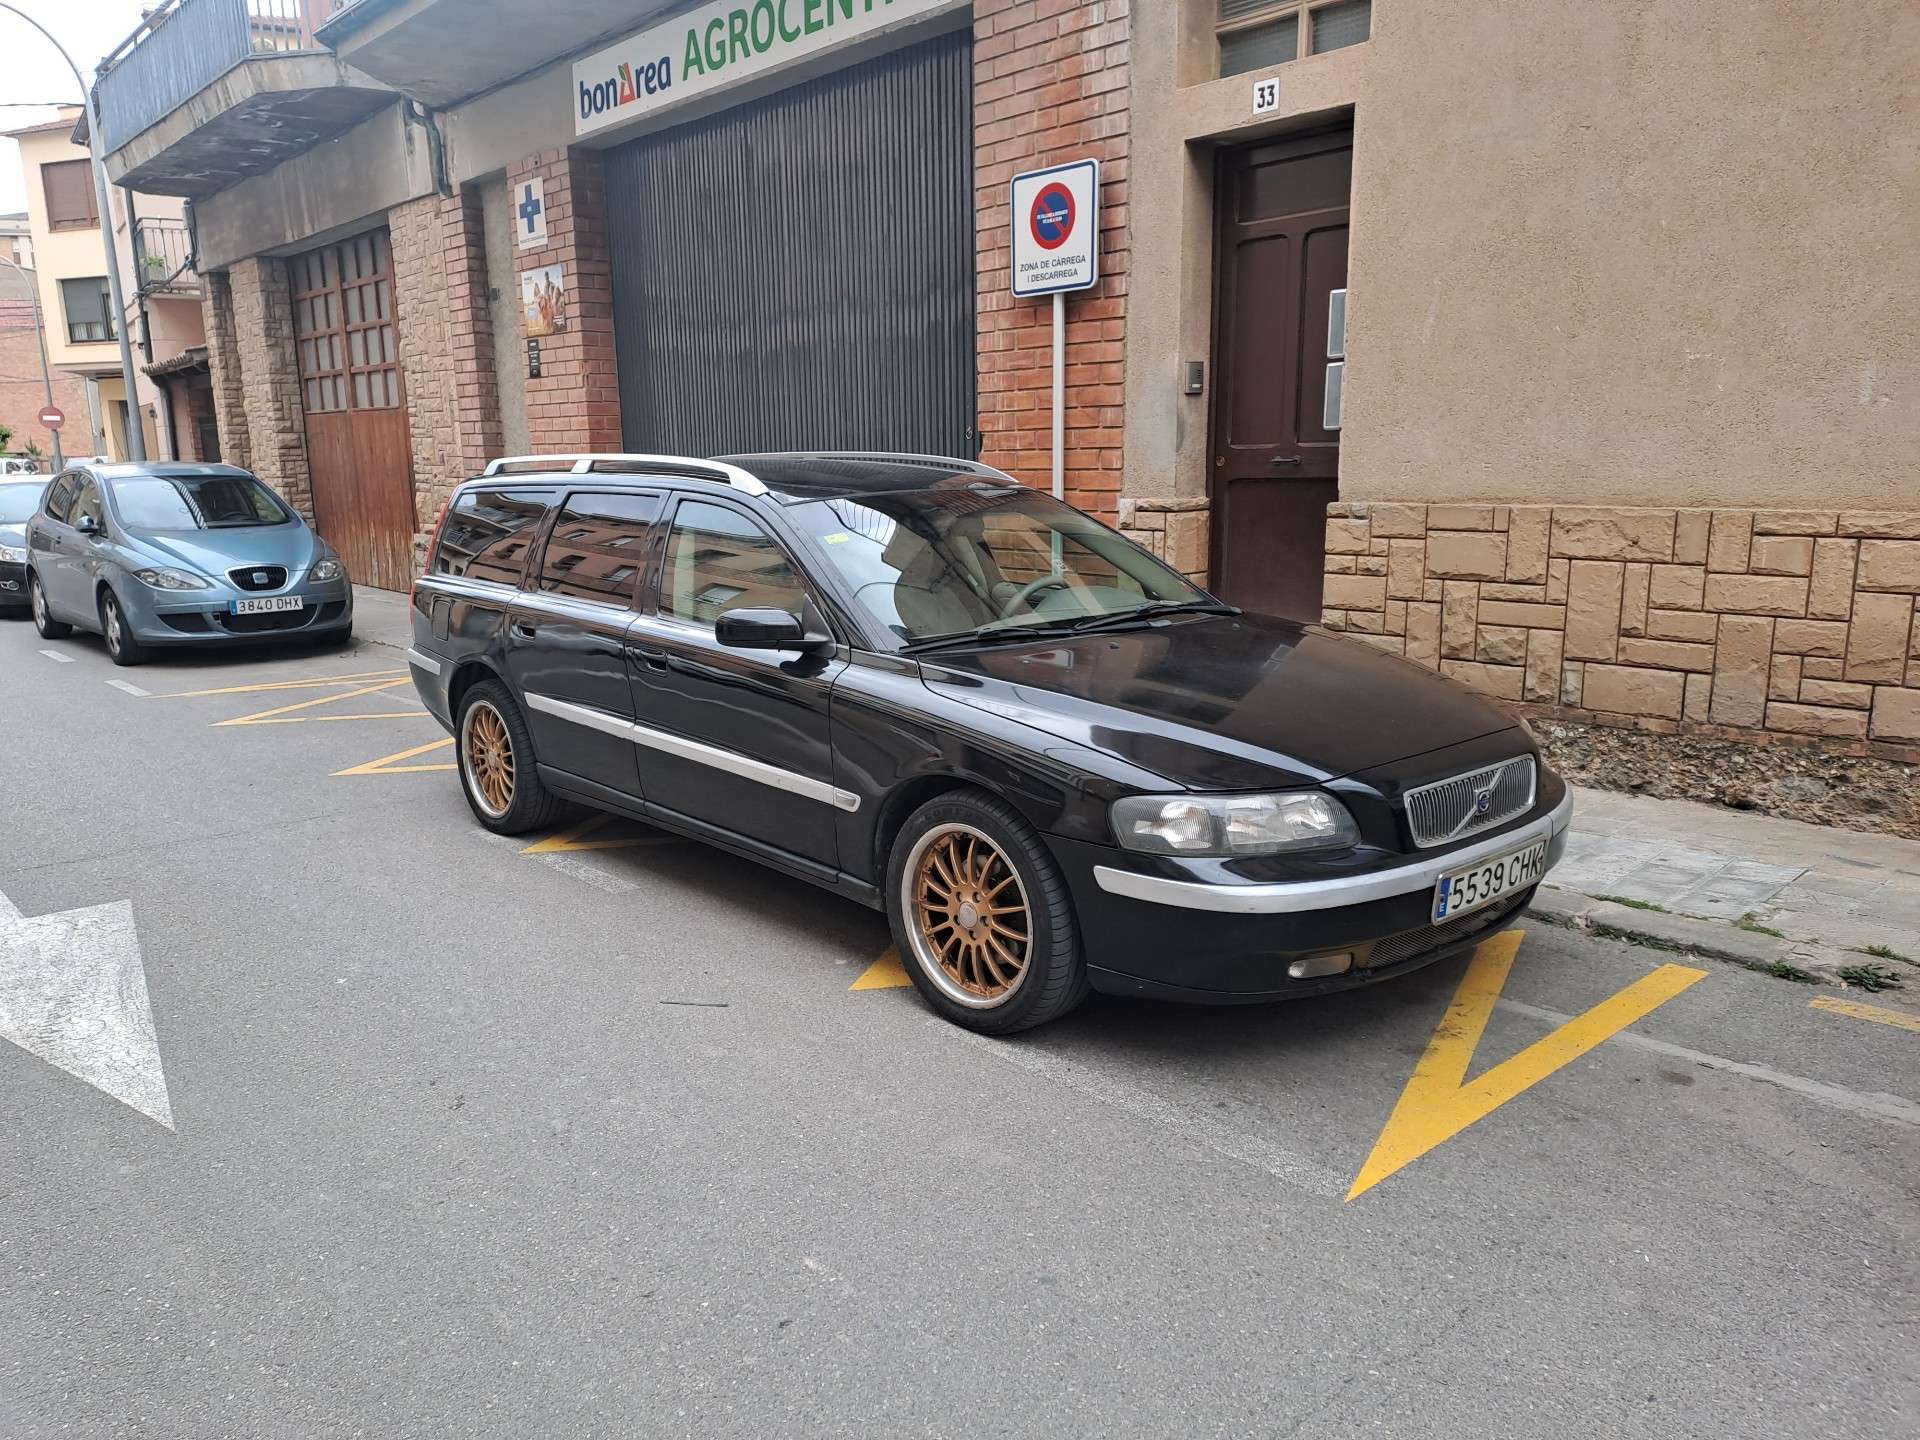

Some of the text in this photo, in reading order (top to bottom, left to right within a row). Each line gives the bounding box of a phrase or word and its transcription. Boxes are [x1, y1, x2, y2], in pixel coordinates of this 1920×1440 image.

[1257, 84, 1275, 108] 33
[1020, 262, 1039, 272] ZONA
[1041, 260, 1050, 269] DE
[239, 597, 300, 612] 3840 DHX
[1452, 843, 1544, 910] 5539 CHK
